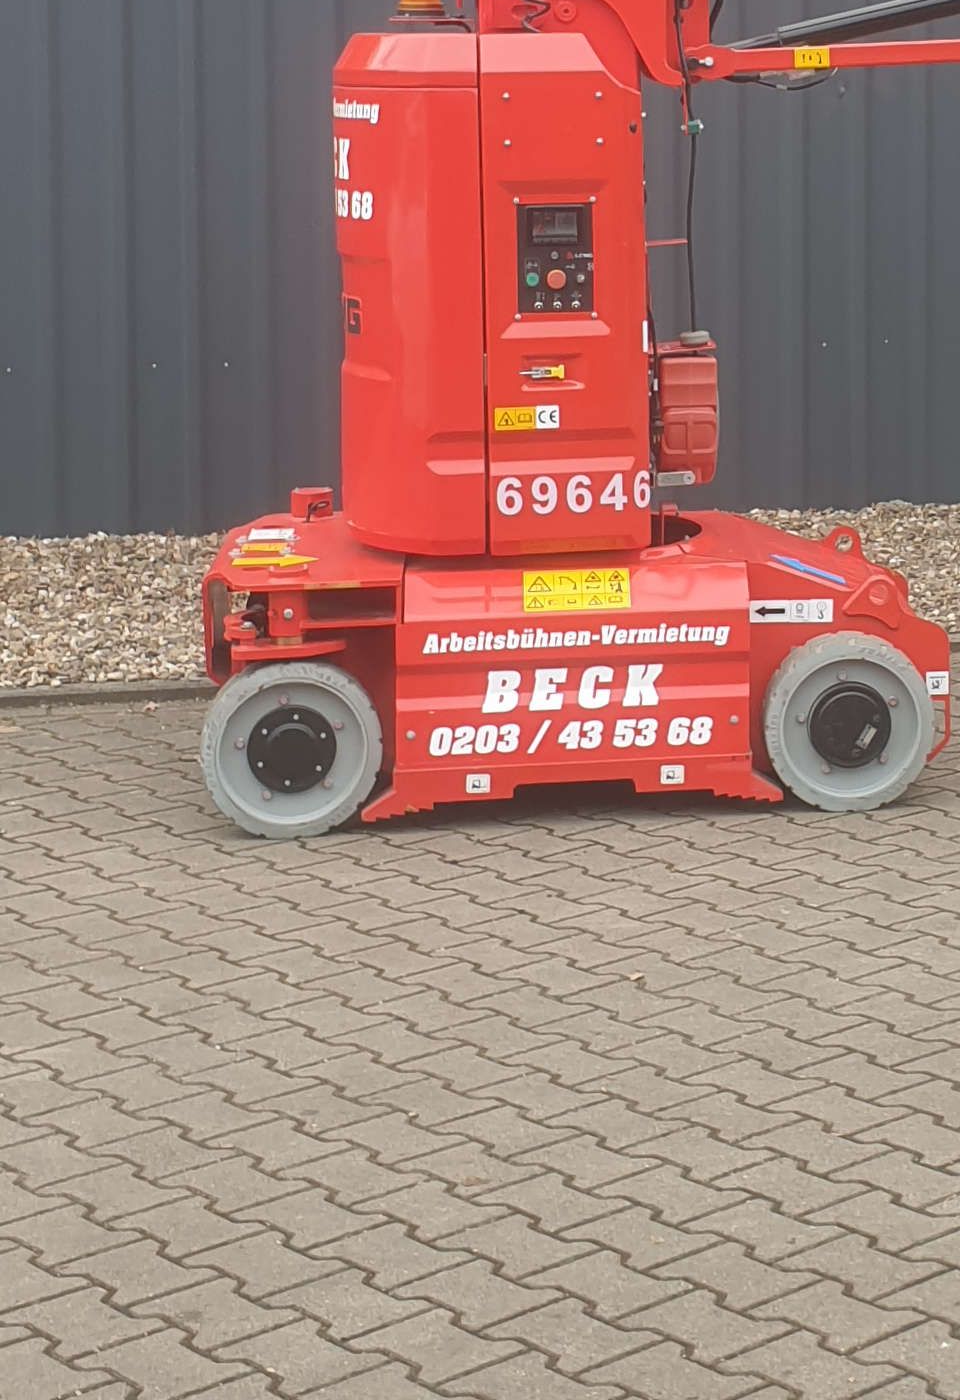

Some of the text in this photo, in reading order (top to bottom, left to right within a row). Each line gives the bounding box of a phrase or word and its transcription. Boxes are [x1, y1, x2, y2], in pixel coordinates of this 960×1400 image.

[351, 190, 373, 220] 68
[537, 409, 558, 424] CE
[496, 469, 651, 516] 69646
[422, 623, 730, 655] Arbeitsbühnen-Vermietung
[481, 663, 664, 714] BECK
[429, 715, 714, 757] 0203 / 43 53 68
